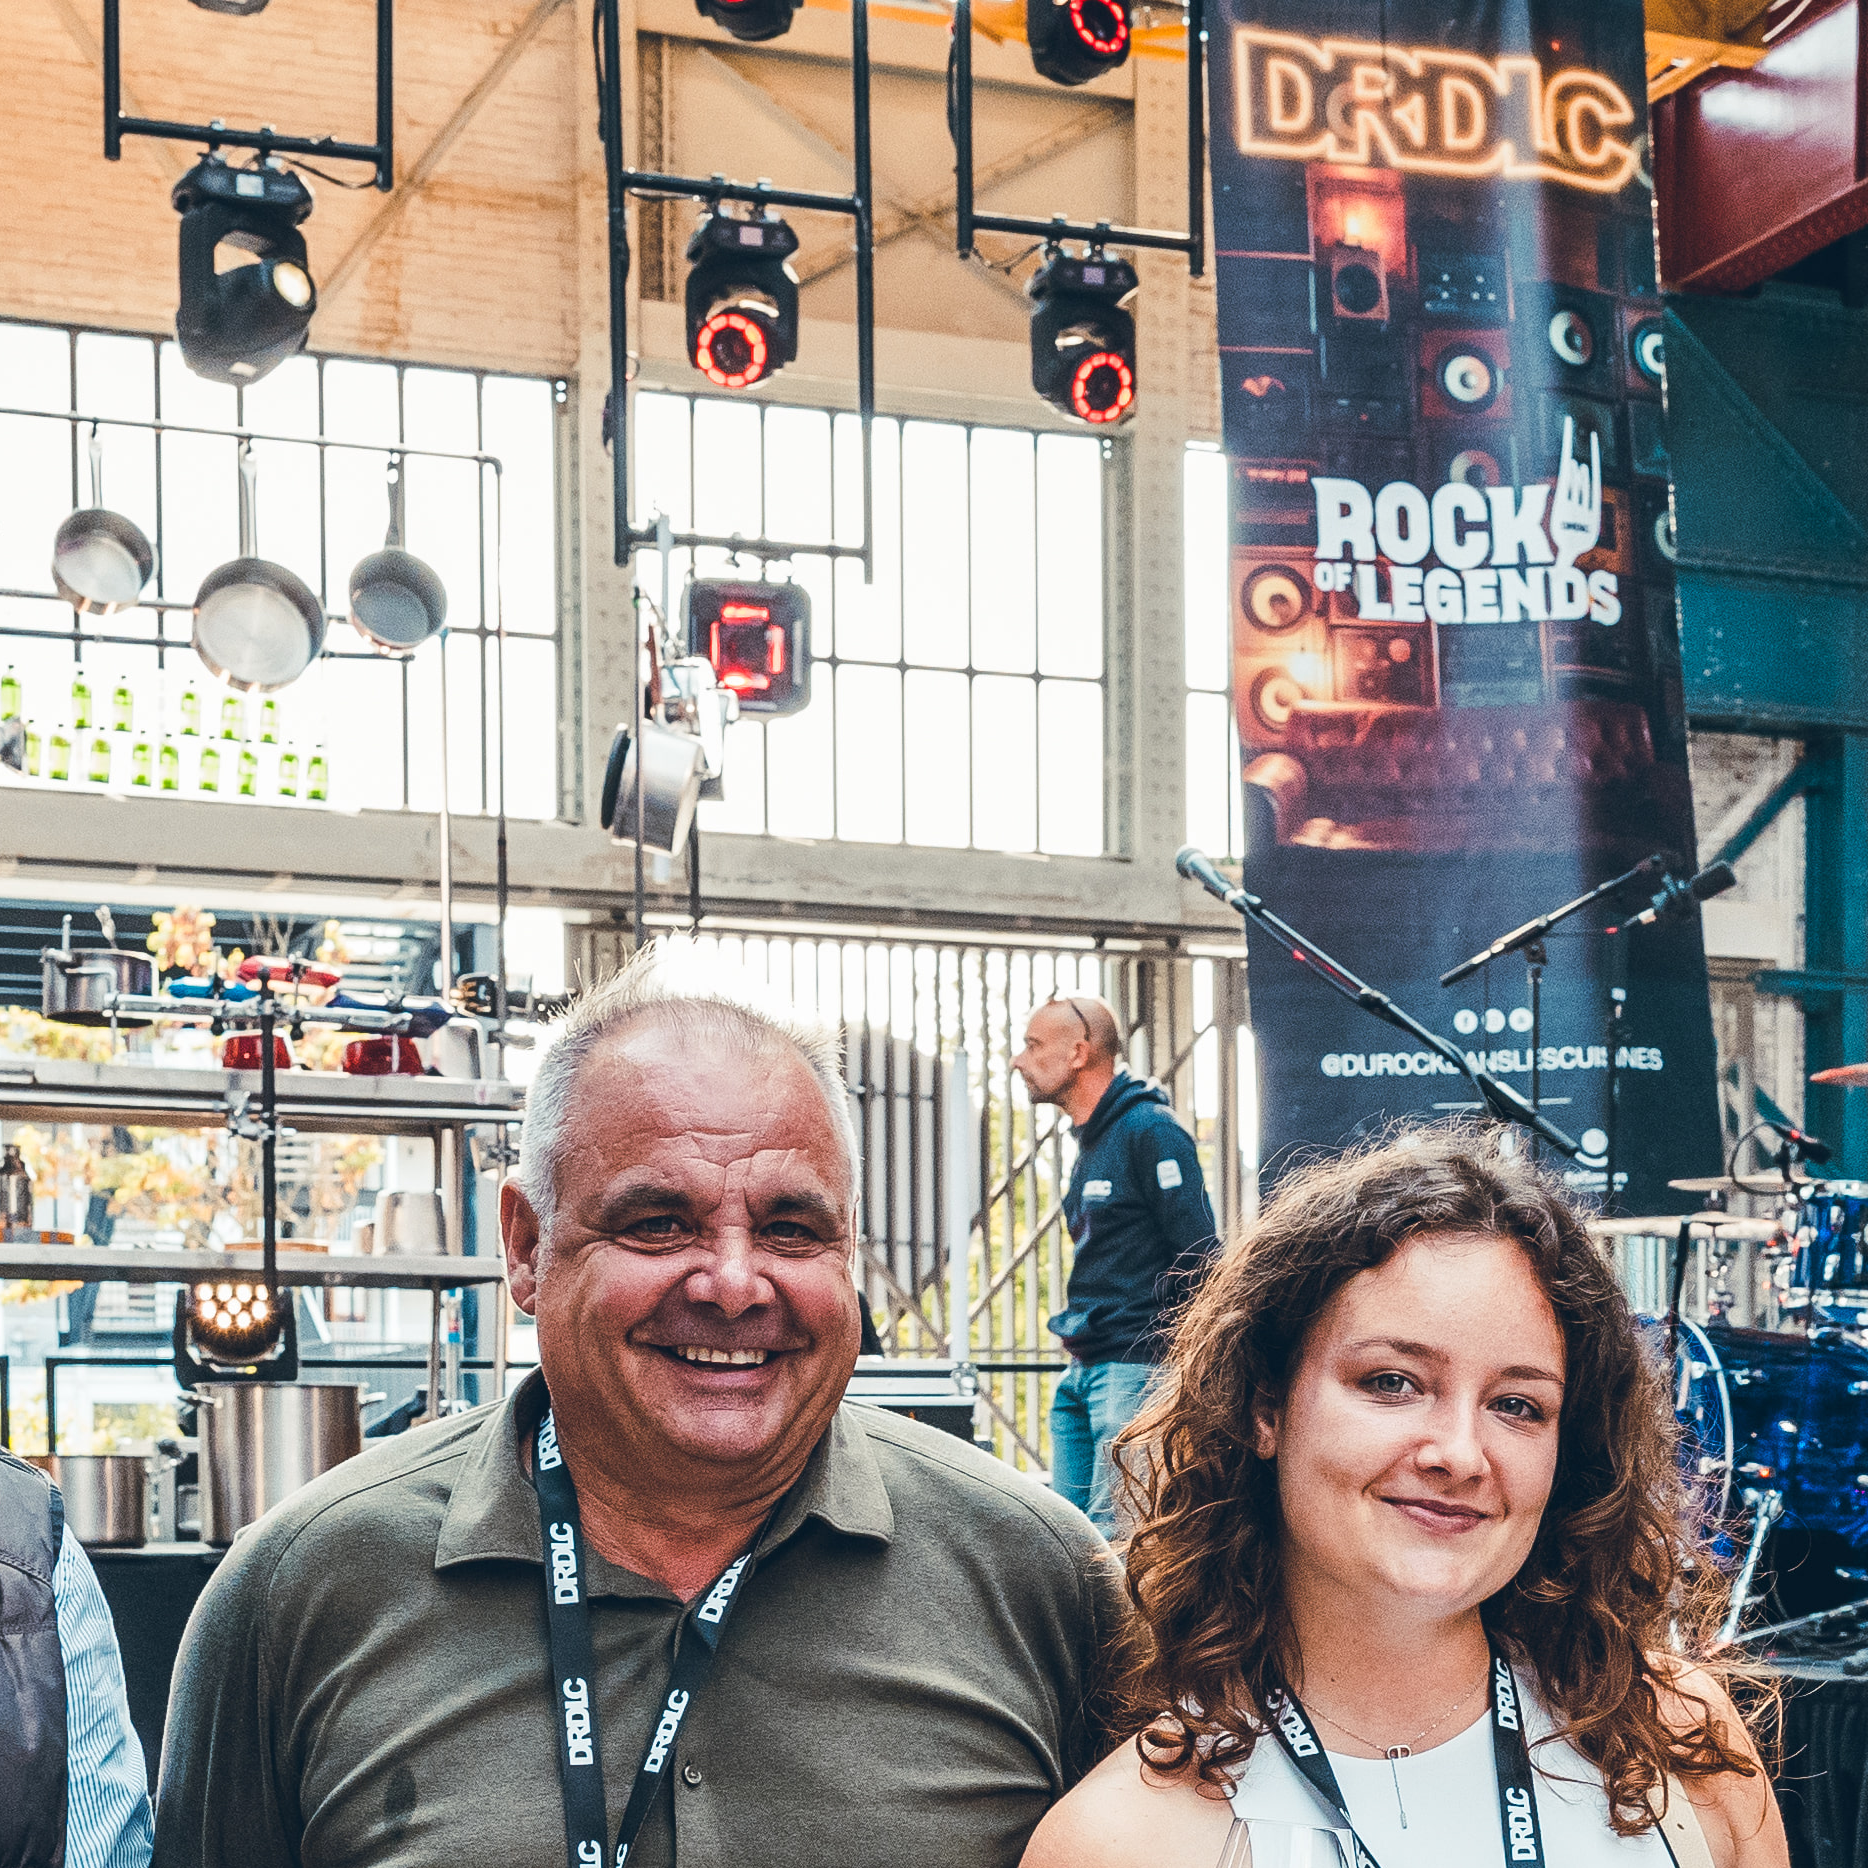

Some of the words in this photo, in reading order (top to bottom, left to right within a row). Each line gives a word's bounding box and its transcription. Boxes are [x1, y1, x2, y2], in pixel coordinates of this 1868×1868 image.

[1232, 30, 1635, 193] DRDLC
[1312, 477, 1556, 569] ROCK
[1314, 563, 1354, 592] OF
[1356, 563, 1622, 626] LEGENDS
[549, 1522, 580, 1605] DRDLC
[562, 1677, 595, 1766] DRDLC
[643, 1689, 690, 1774] DRDLC
[1495, 1657, 1520, 1731] DRDLC
[1506, 1786, 1538, 1861] DRDLC
